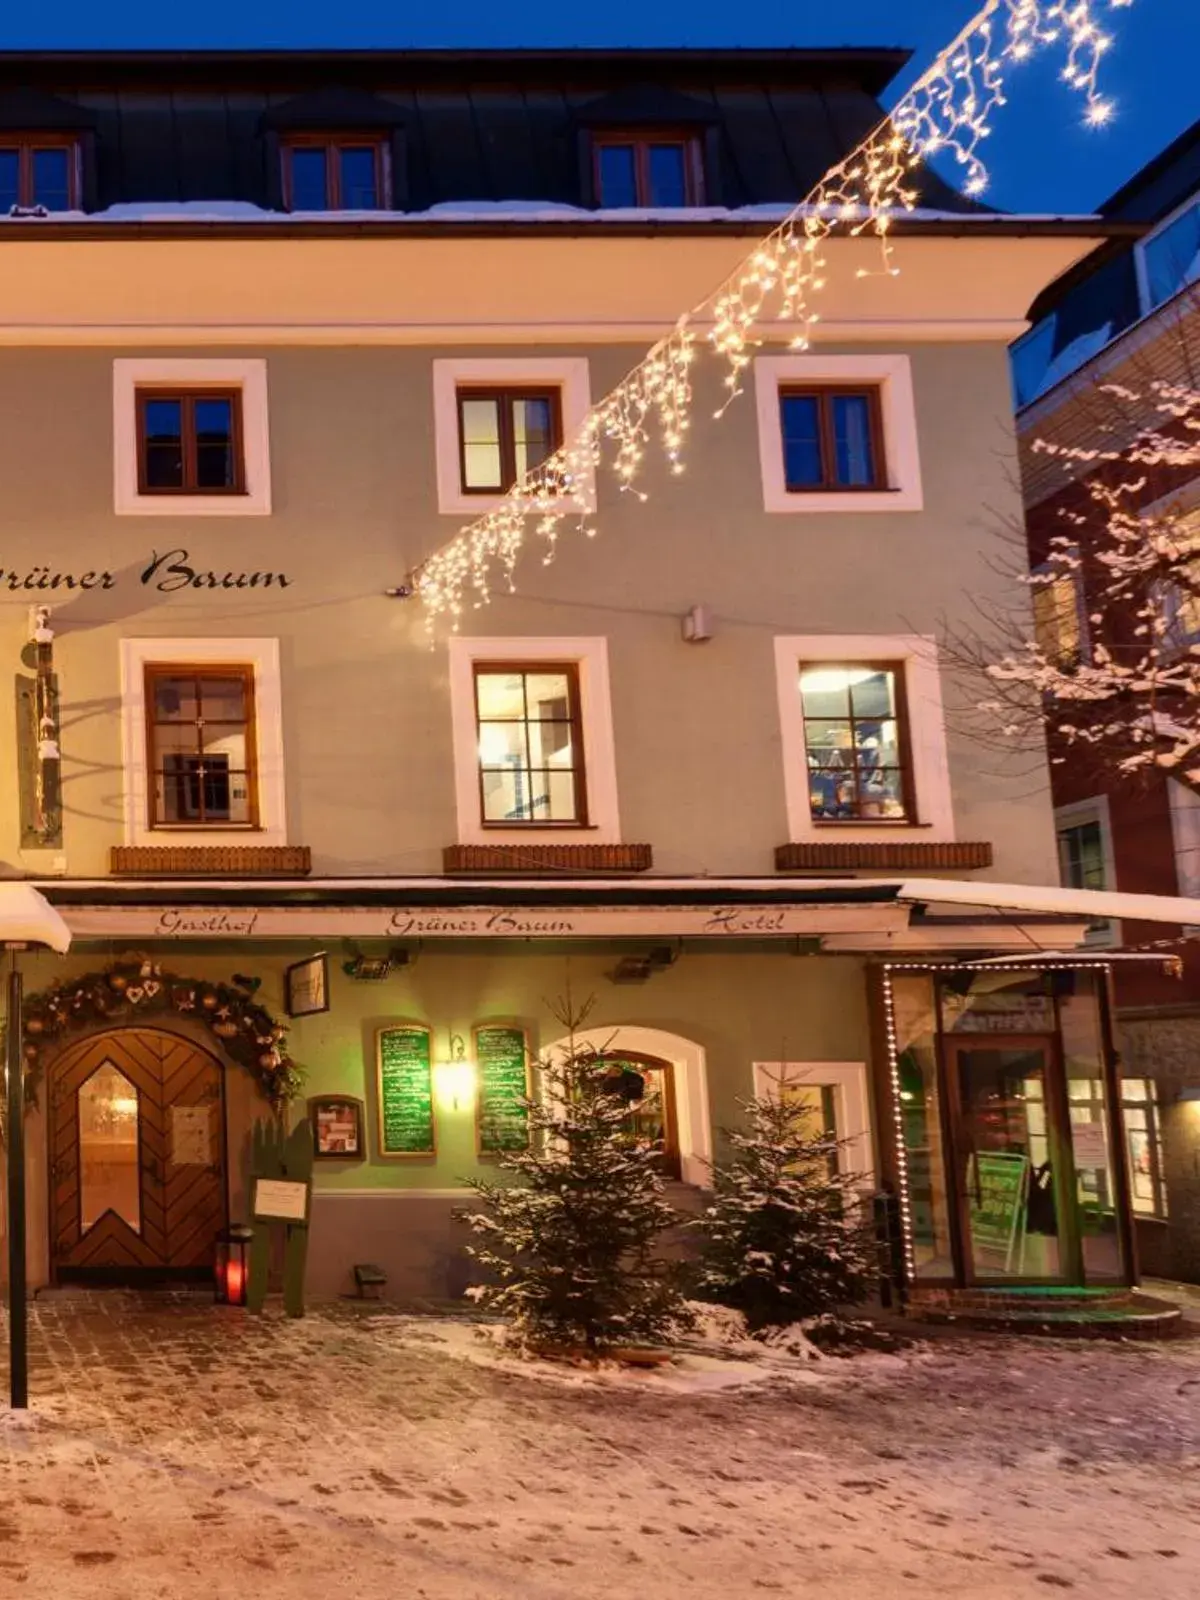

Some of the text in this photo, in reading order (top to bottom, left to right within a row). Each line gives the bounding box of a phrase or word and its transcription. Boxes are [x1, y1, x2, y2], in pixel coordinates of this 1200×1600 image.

[140, 549, 294, 592] Baum
[155, 909, 785, 935] Gasthof Grüner Baum Hotel
